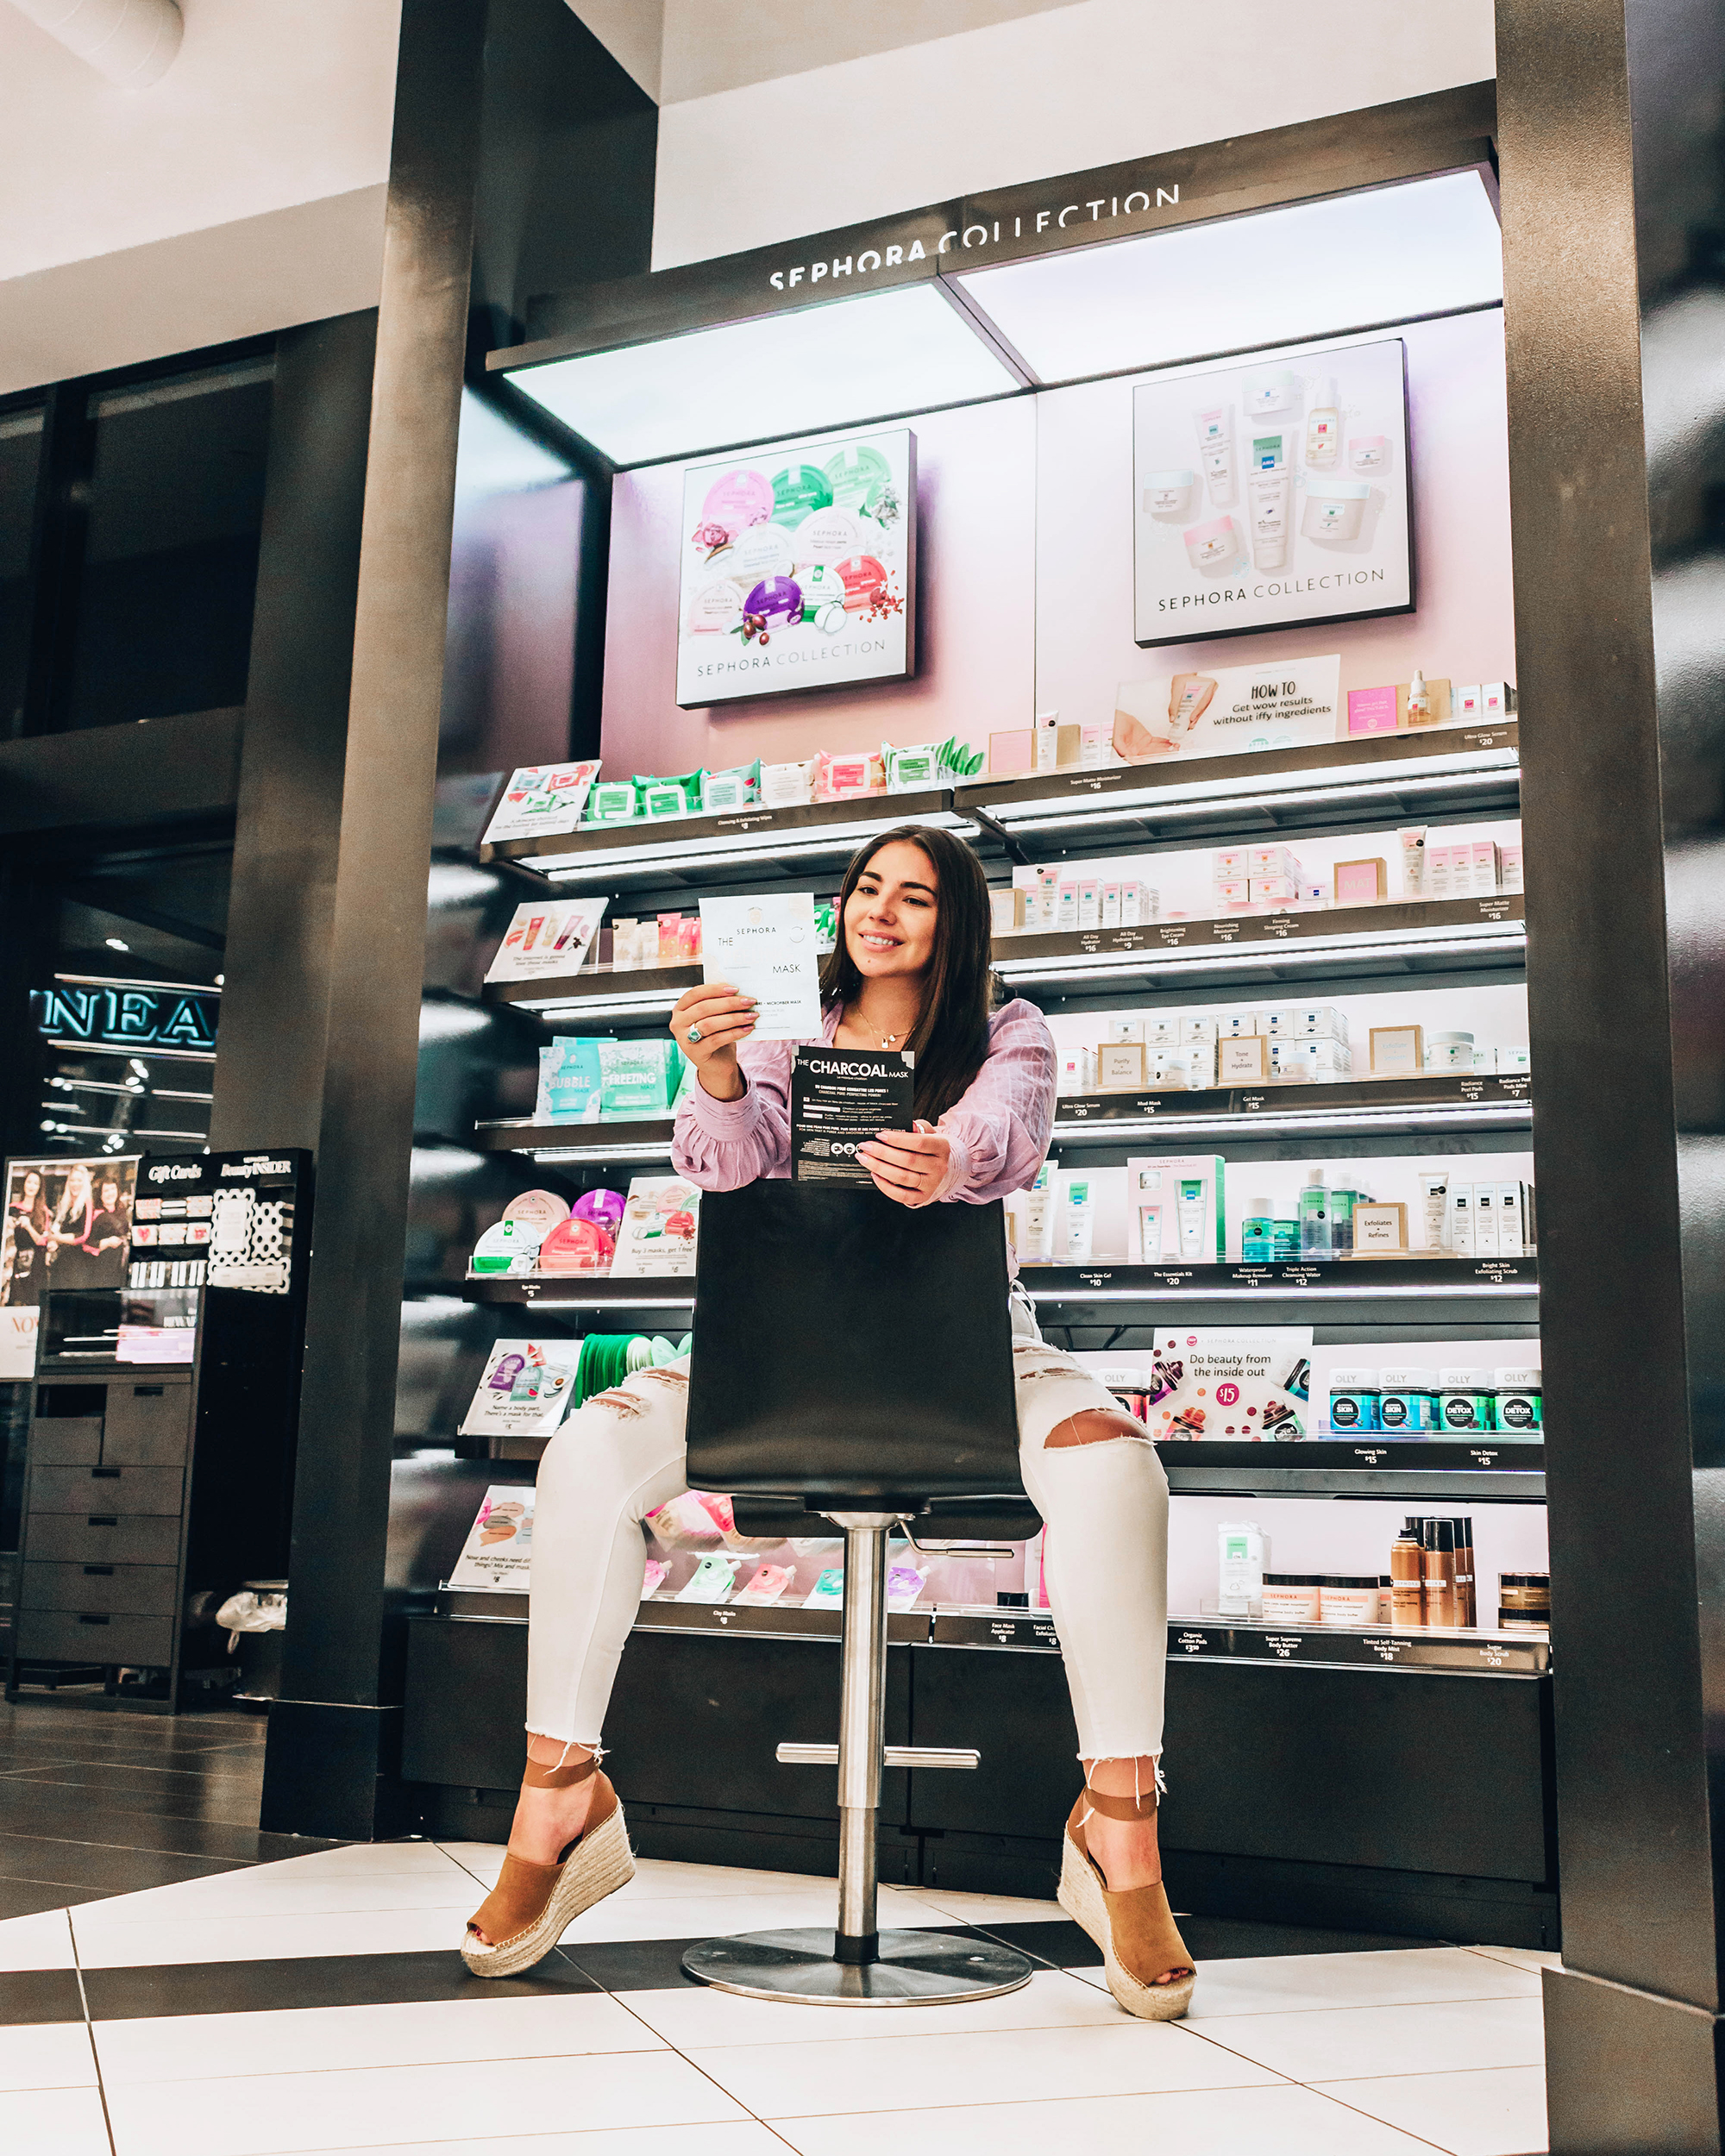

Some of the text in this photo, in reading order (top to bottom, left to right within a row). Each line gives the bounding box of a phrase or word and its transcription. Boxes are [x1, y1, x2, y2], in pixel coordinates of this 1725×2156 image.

[769, 184, 1180, 290] SEPHORA COLLECTION
[1158, 568, 1384, 611] SEPHORA COLLECTION
[697, 639, 886, 677] SEPHORA COLLECTION
[1251, 681, 1296, 699] HOW TO
[1233, 696, 1313, 713] Get wow results
[1213, 705, 1332, 726] without iffy ingredients
[1344, 877, 1372, 891] MAT
[718, 937, 733, 946] THE
[773, 964, 800, 974] MASK
[809, 1060, 888, 1078] CHARCOAL
[609, 1073, 656, 1085] FREEZING
[148, 1164, 203, 1183] Gift Cards
[1490, 1275, 1502, 1283] $12
[1189, 1354, 1271, 1365] Do beauty from
[1194, 1367, 1265, 1376] the inside out
[1504, 1374, 1527, 1382] OLLY
[1220, 1388, 1235, 1402] $15
[1380, 1652, 1394, 1661] $18
